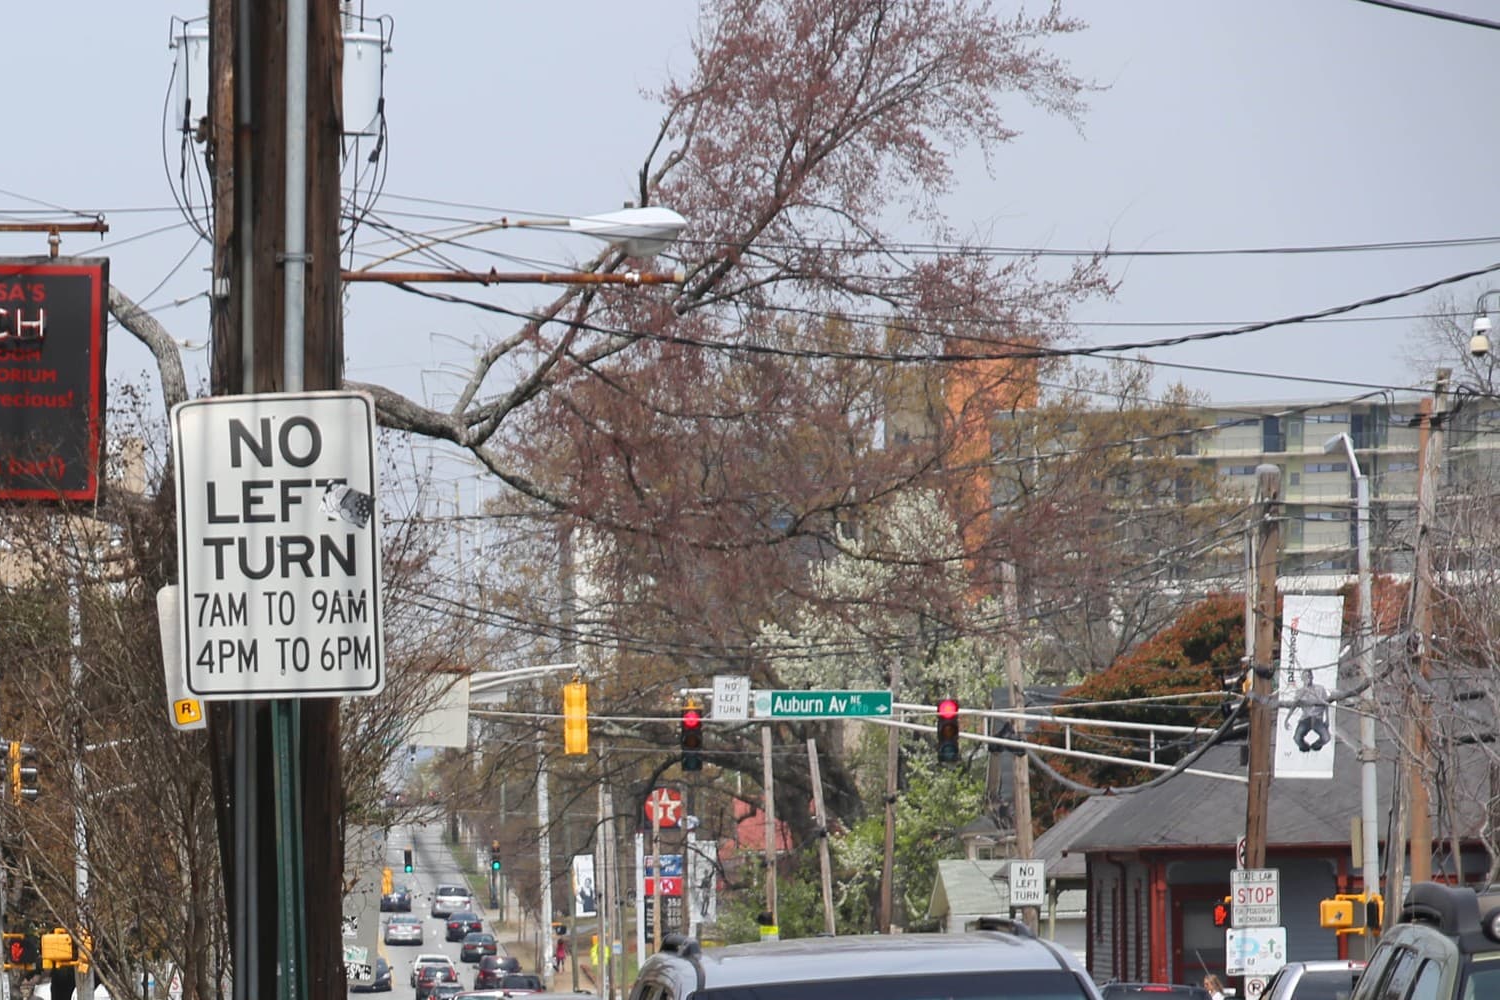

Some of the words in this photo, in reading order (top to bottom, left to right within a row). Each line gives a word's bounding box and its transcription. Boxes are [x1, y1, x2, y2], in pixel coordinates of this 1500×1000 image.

[228, 416, 323, 468] NO
[202, 533, 357, 581] TURN
[194, 592, 248, 628] 7AM
[262, 590, 296, 626] TO
[312, 589, 368, 625] 9AM
[196, 639, 259, 674] 4PM
[275, 637, 311, 673] TO
[320, 636, 372, 671] 6PM
[724, 682, 738, 691] NO
[719, 694, 741, 703] LEFT
[773, 695, 823, 713] Auburn
[828, 695, 847, 713] Av
[850, 694, 862, 704] NE
[718, 705, 742, 714] TURN
[1019, 866, 1035, 877] NO
[1015, 879, 1038, 889] LEFT
[1014, 890, 1040, 901] TURN
[1238, 887, 1274, 904] STOP
